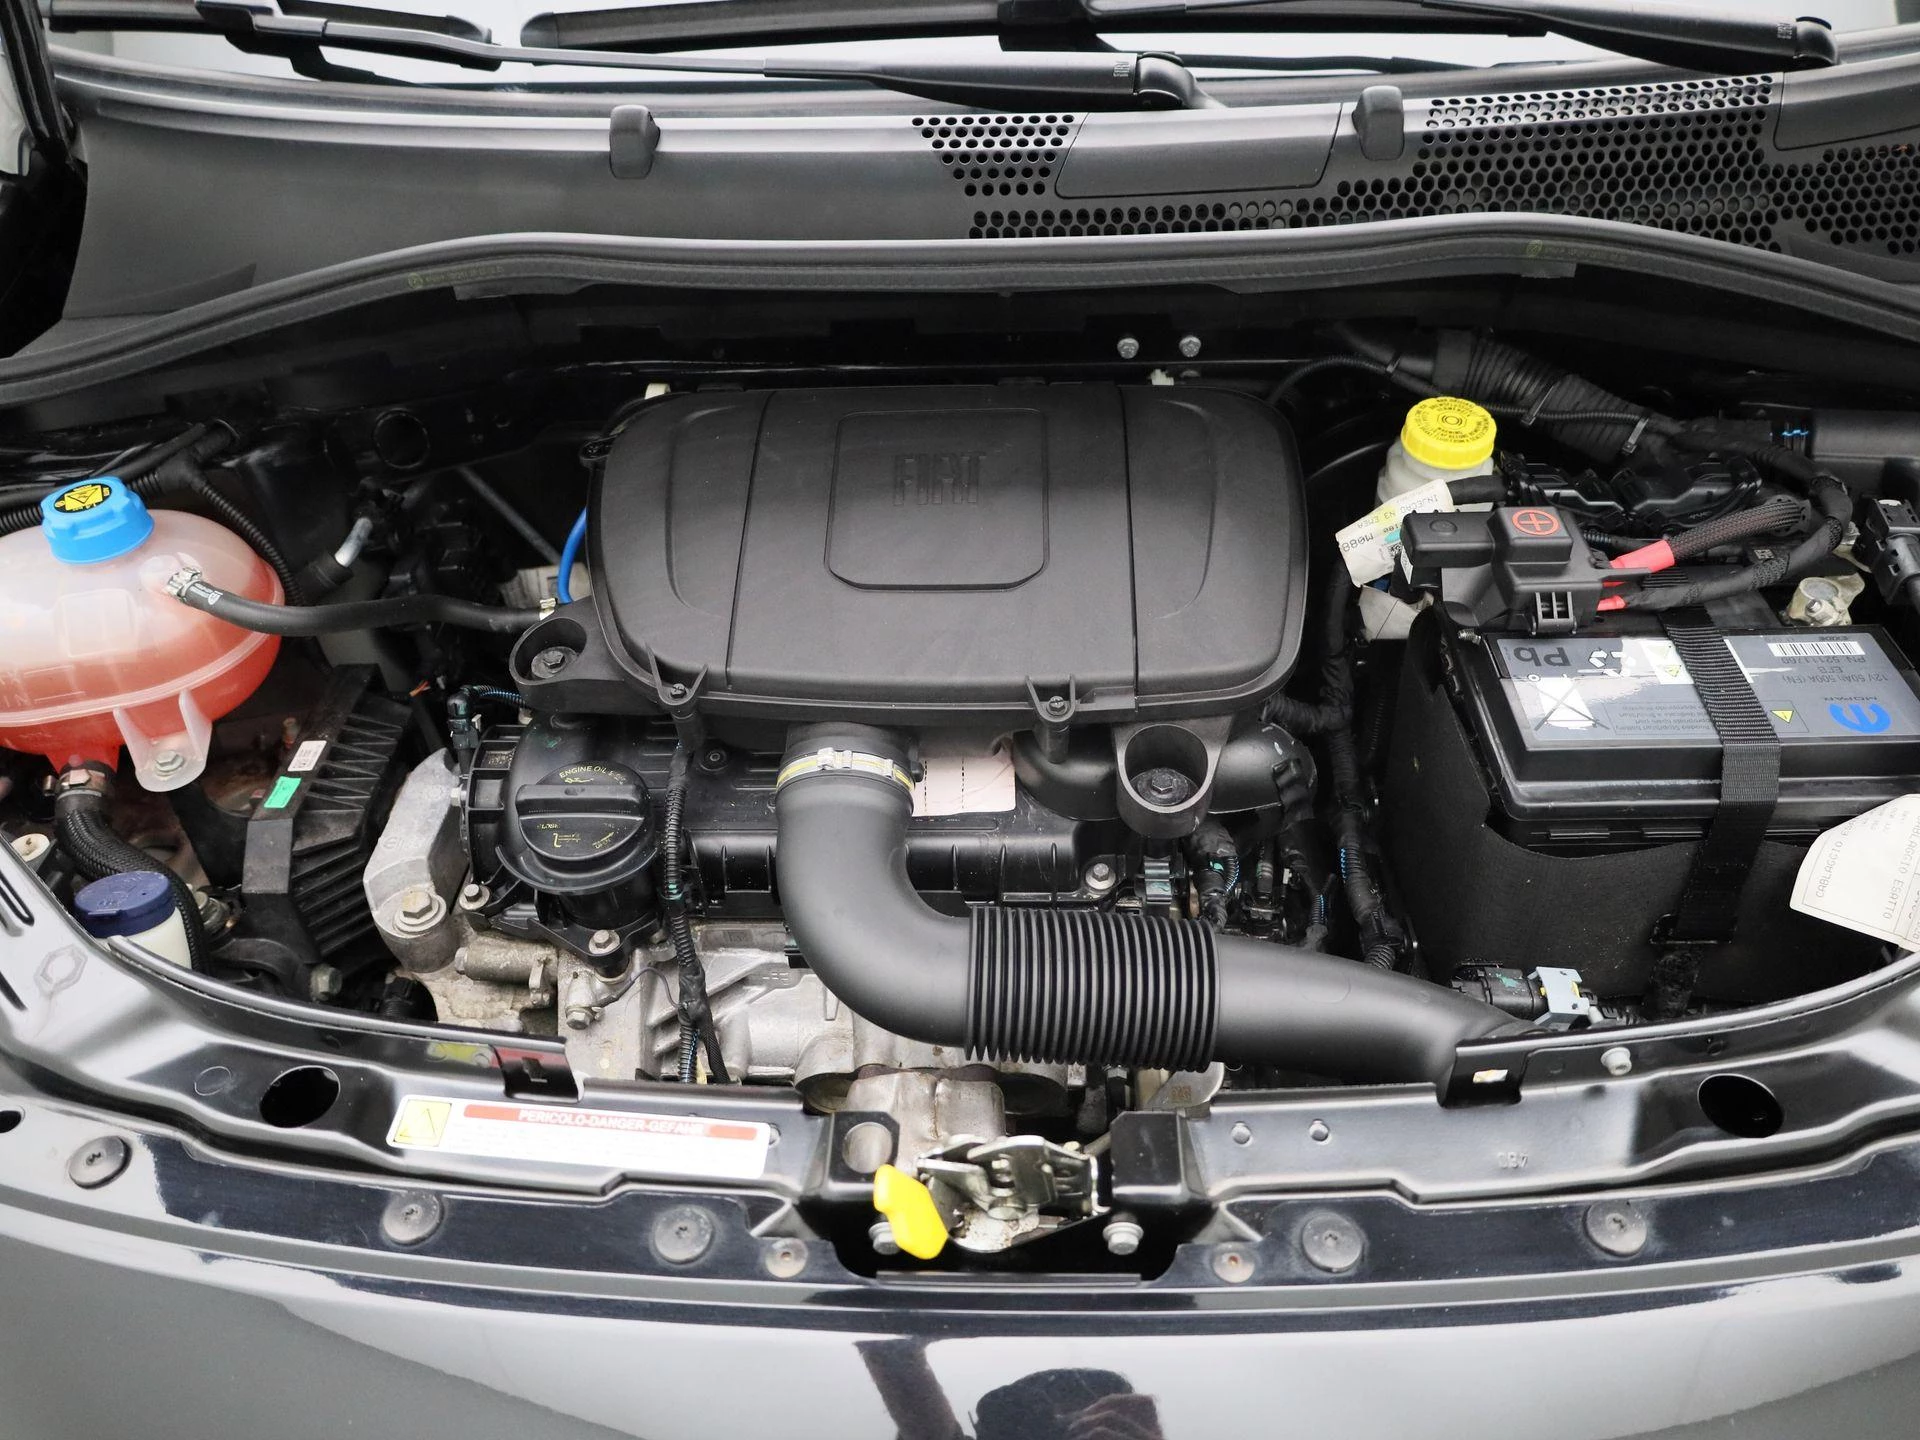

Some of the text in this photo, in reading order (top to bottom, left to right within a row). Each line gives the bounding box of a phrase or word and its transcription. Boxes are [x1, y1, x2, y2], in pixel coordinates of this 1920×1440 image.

[893, 451, 987, 506] FIAT
[1513, 646, 1571, 667] Pb
[559, 765, 607, 779] ENGINE OIL
[1815, 840, 1844, 899] CABLAGGIO
[1882, 879, 1904, 920] ESATTO
